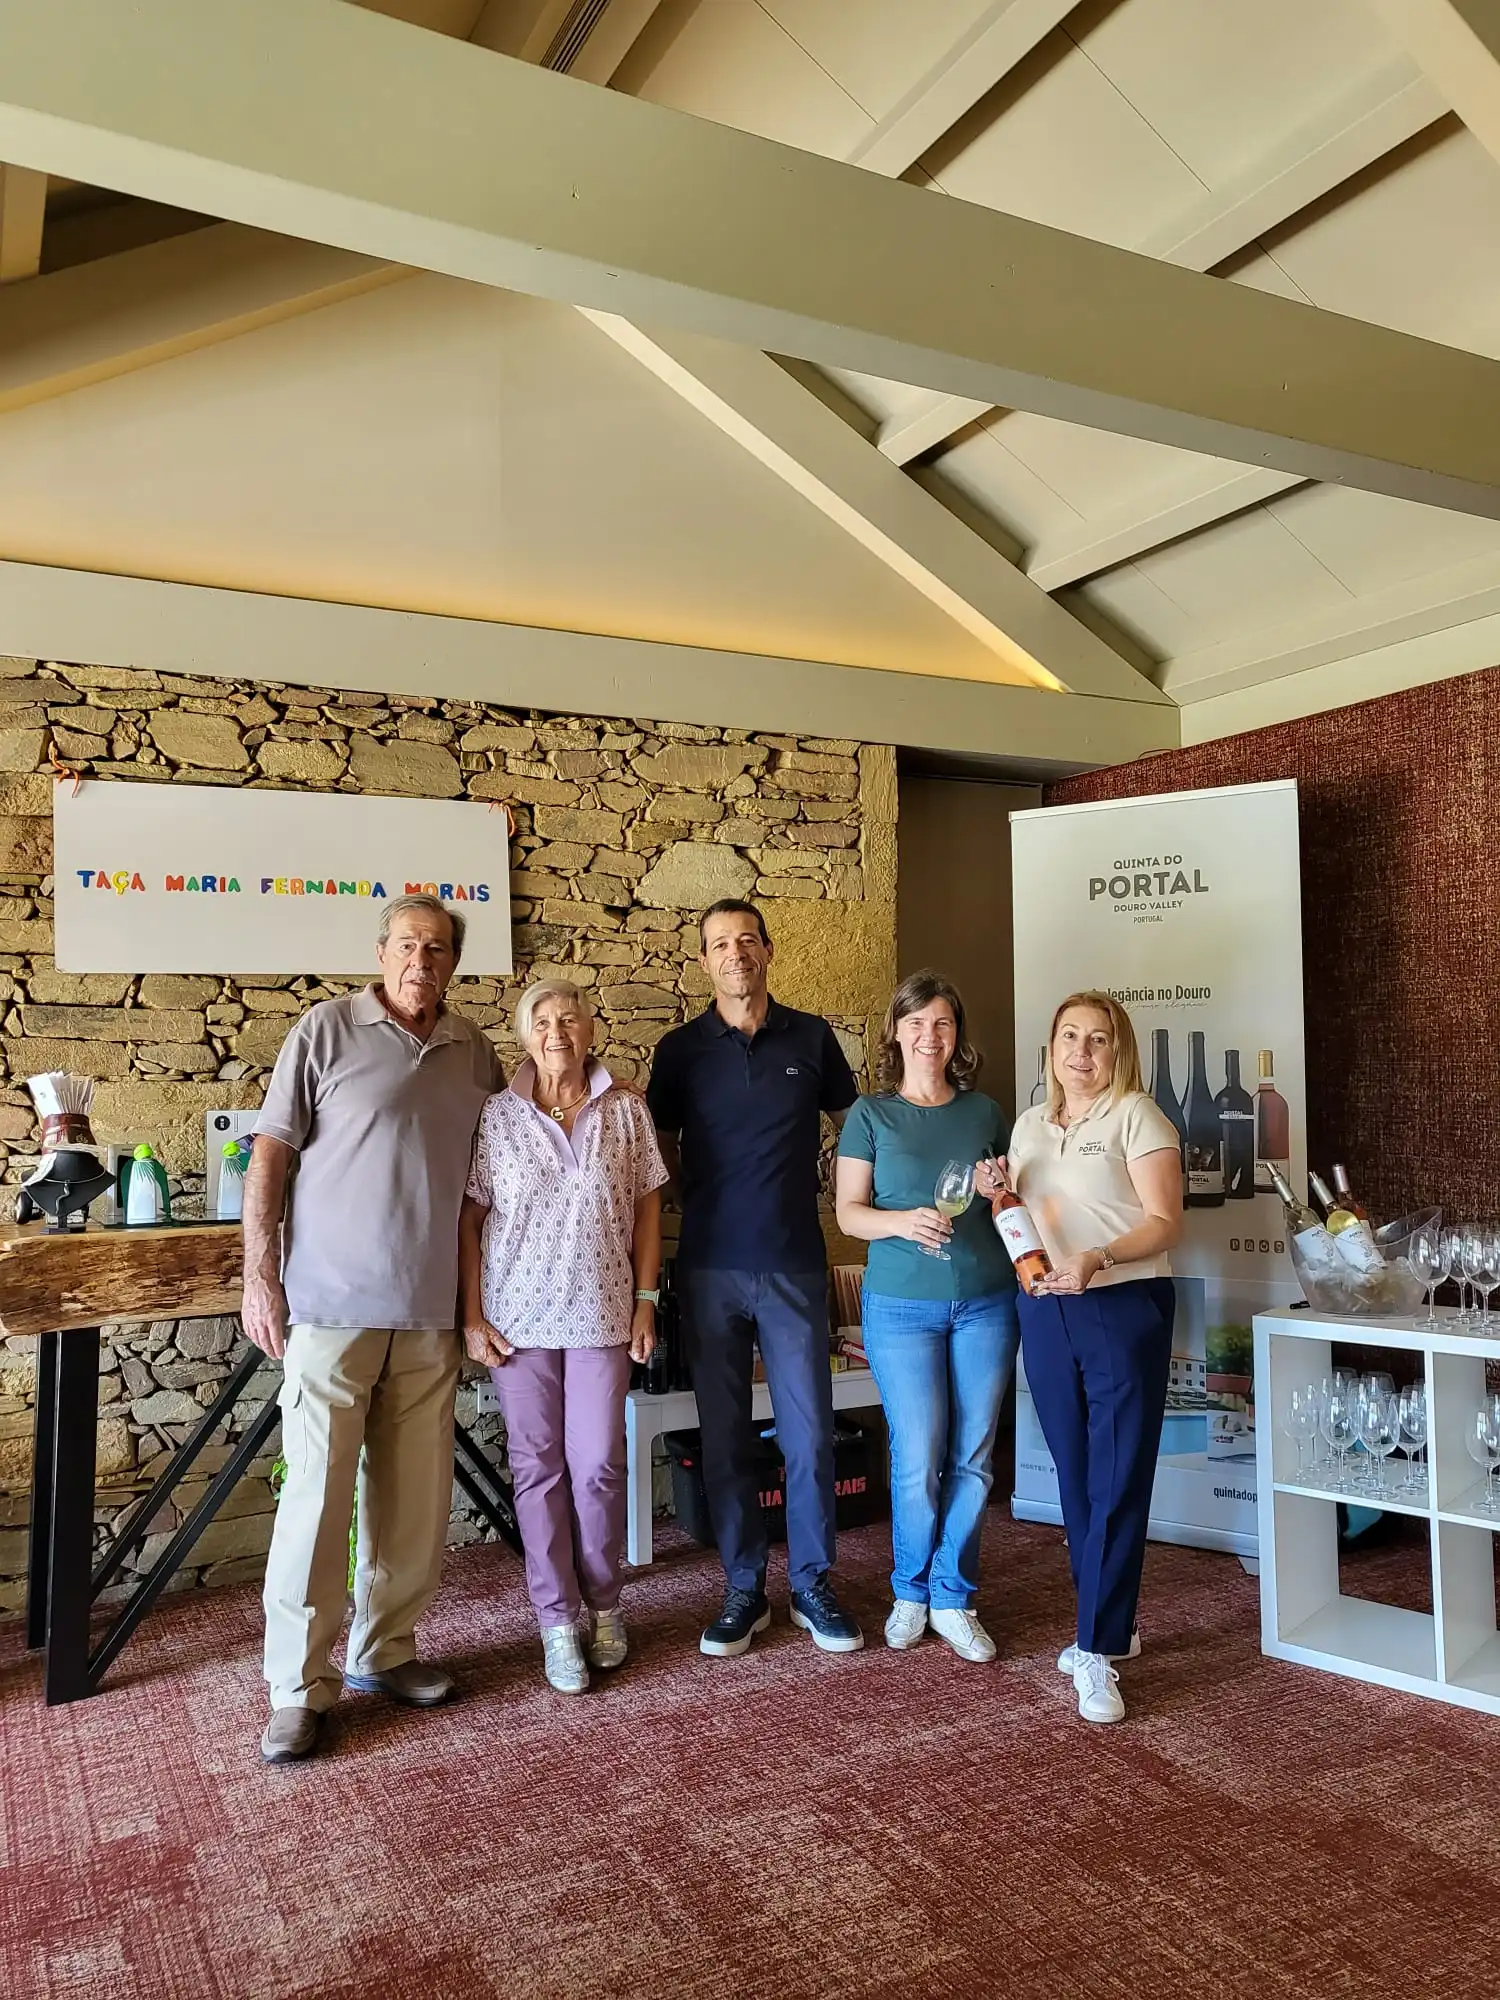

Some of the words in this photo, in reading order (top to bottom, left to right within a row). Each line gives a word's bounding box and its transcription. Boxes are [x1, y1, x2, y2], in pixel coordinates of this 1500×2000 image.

[1113, 857, 1160, 870] QUINTA
[1164, 854, 1183, 866] DO
[76, 870, 146, 895] TAÇA
[165, 874, 242, 893] MARIA
[260, 877, 388, 898] FERNANDA
[404, 882, 490, 903] MORAIS
[1089, 869, 1209, 901] PORTAL
[1113, 902, 1148, 912] DOURO
[1149, 900, 1184, 910] VALLEY
[1133, 915, 1164, 925] PORTUGAL
[1106, 986, 1155, 1004] legância
[1157, 987, 1173, 1001] no
[1175, 984, 1212, 1000] Douro
[1079, 1145, 1107, 1153] PORTAL
